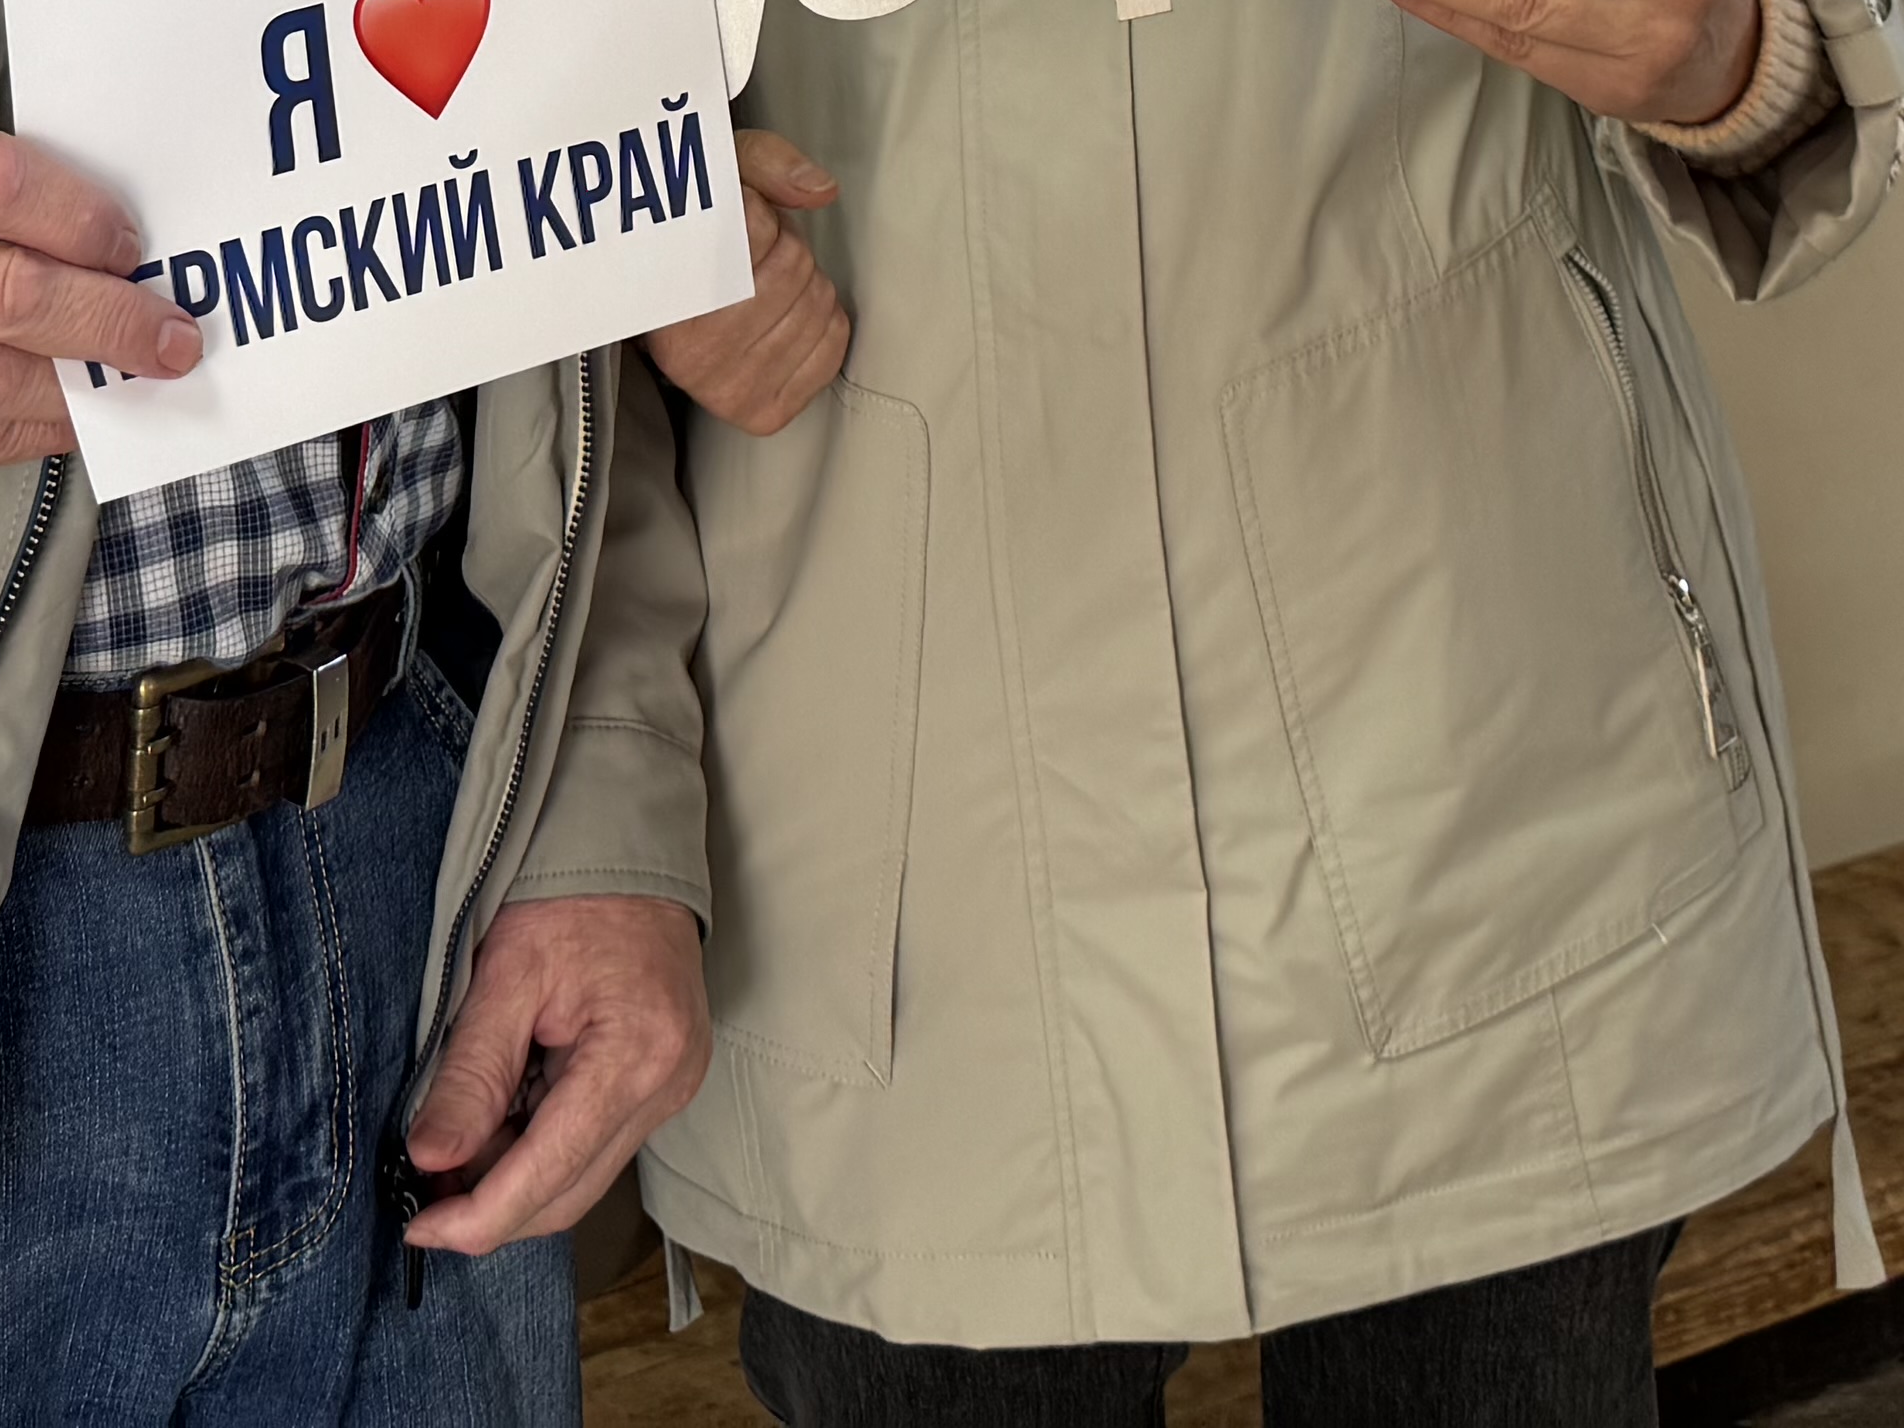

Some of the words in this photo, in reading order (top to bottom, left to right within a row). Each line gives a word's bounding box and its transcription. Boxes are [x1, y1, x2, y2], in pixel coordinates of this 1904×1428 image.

[259, 1, 342, 176] Я
[85, 148, 503, 389] РМСКИЙ
[517, 92, 713, 261] КРАЙ
